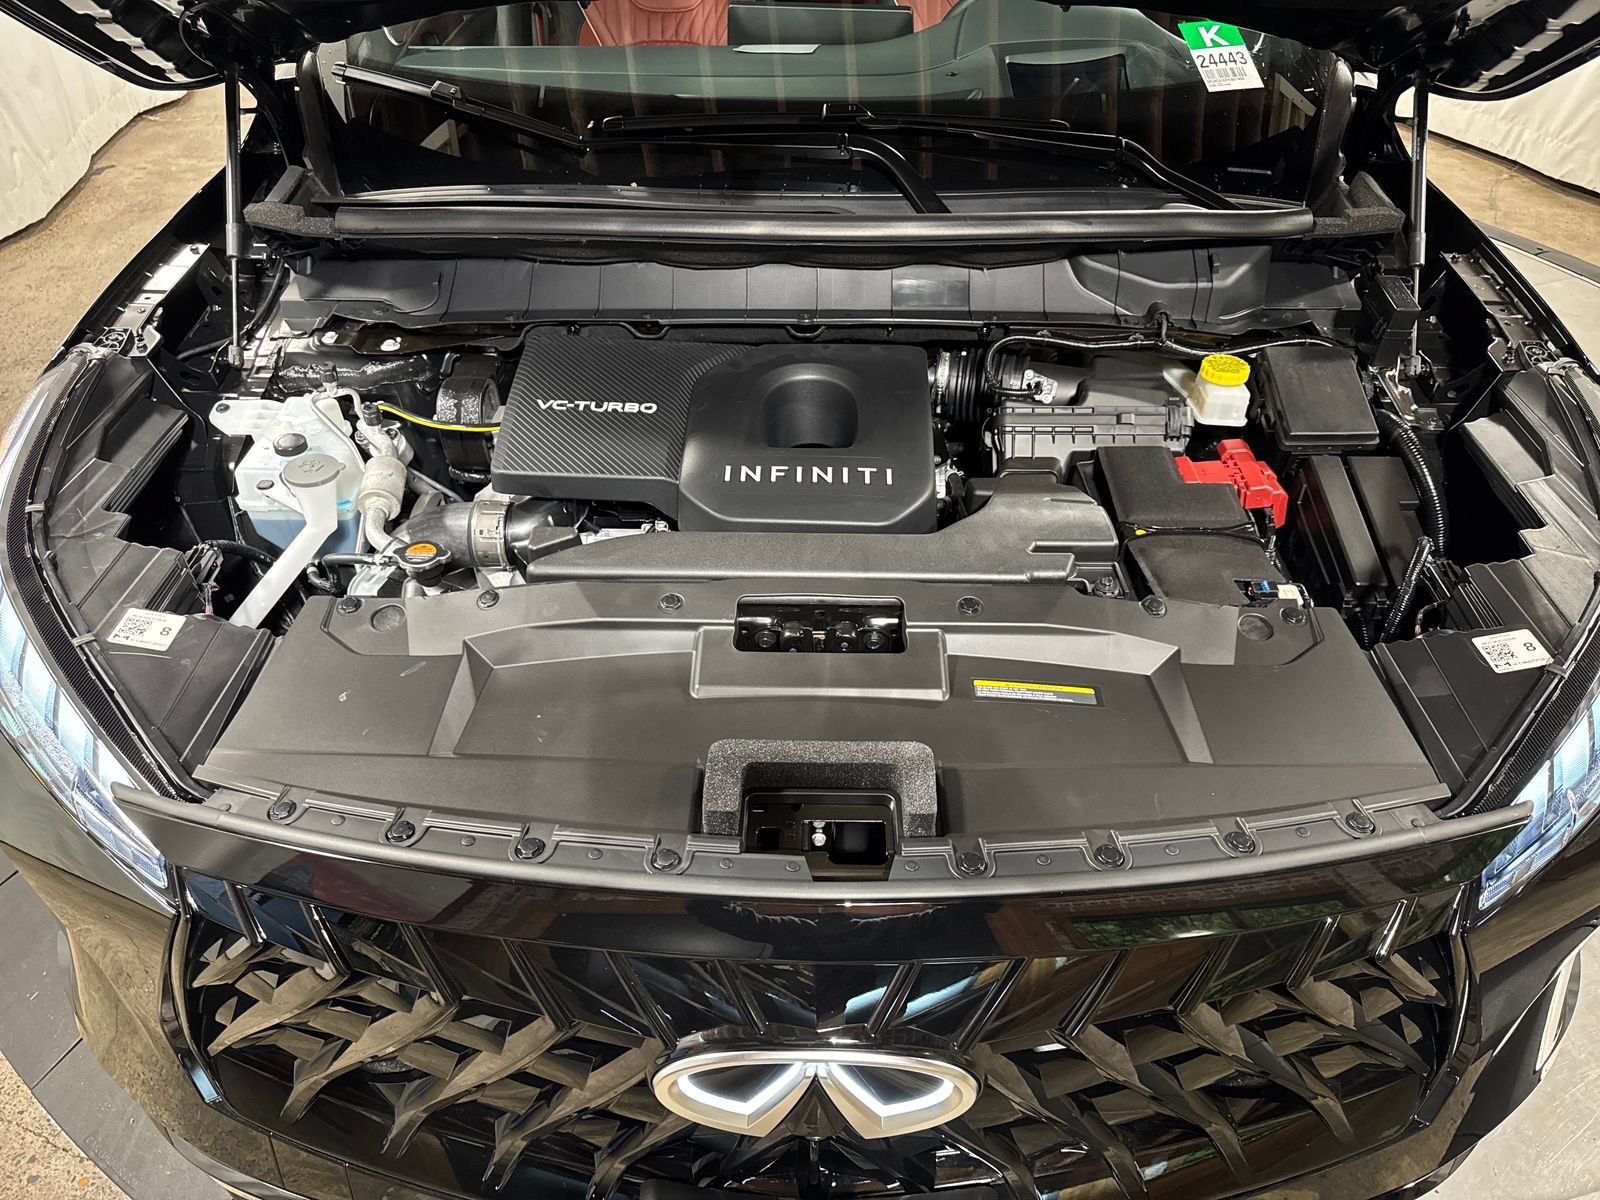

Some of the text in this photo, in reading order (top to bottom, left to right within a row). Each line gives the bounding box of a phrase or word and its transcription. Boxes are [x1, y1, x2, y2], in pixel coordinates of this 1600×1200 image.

[1198, 24, 1230, 47] K
[1196, 51, 1248, 69] 24443
[536, 399, 658, 414] VC-TURBO
[723, 465, 893, 486] INFINITI
[159, 626, 172, 637] 8
[1523, 641, 1537, 652] 8
